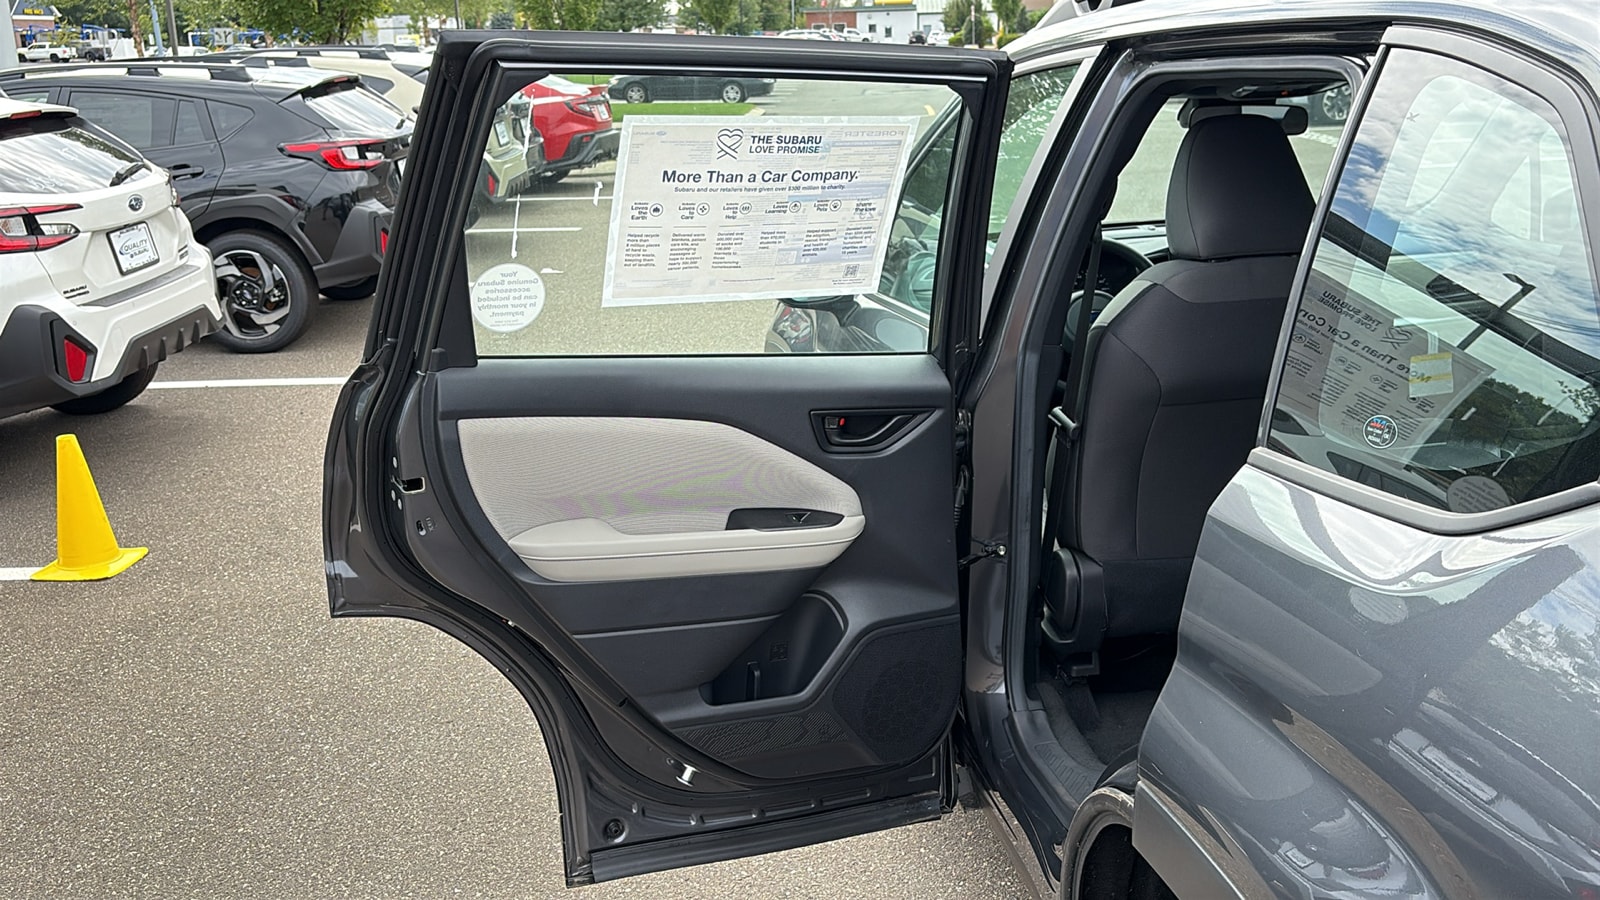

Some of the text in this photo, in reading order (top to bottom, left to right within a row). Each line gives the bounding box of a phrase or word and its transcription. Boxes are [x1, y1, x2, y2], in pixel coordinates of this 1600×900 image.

[750, 136, 774, 144] THE
[776, 135, 822, 144] SUBARU
[776, 146, 821, 154] PROMISE
[662, 170, 859, 184] More Than a Car Company.
[124, 239, 148, 252] QUALITY
